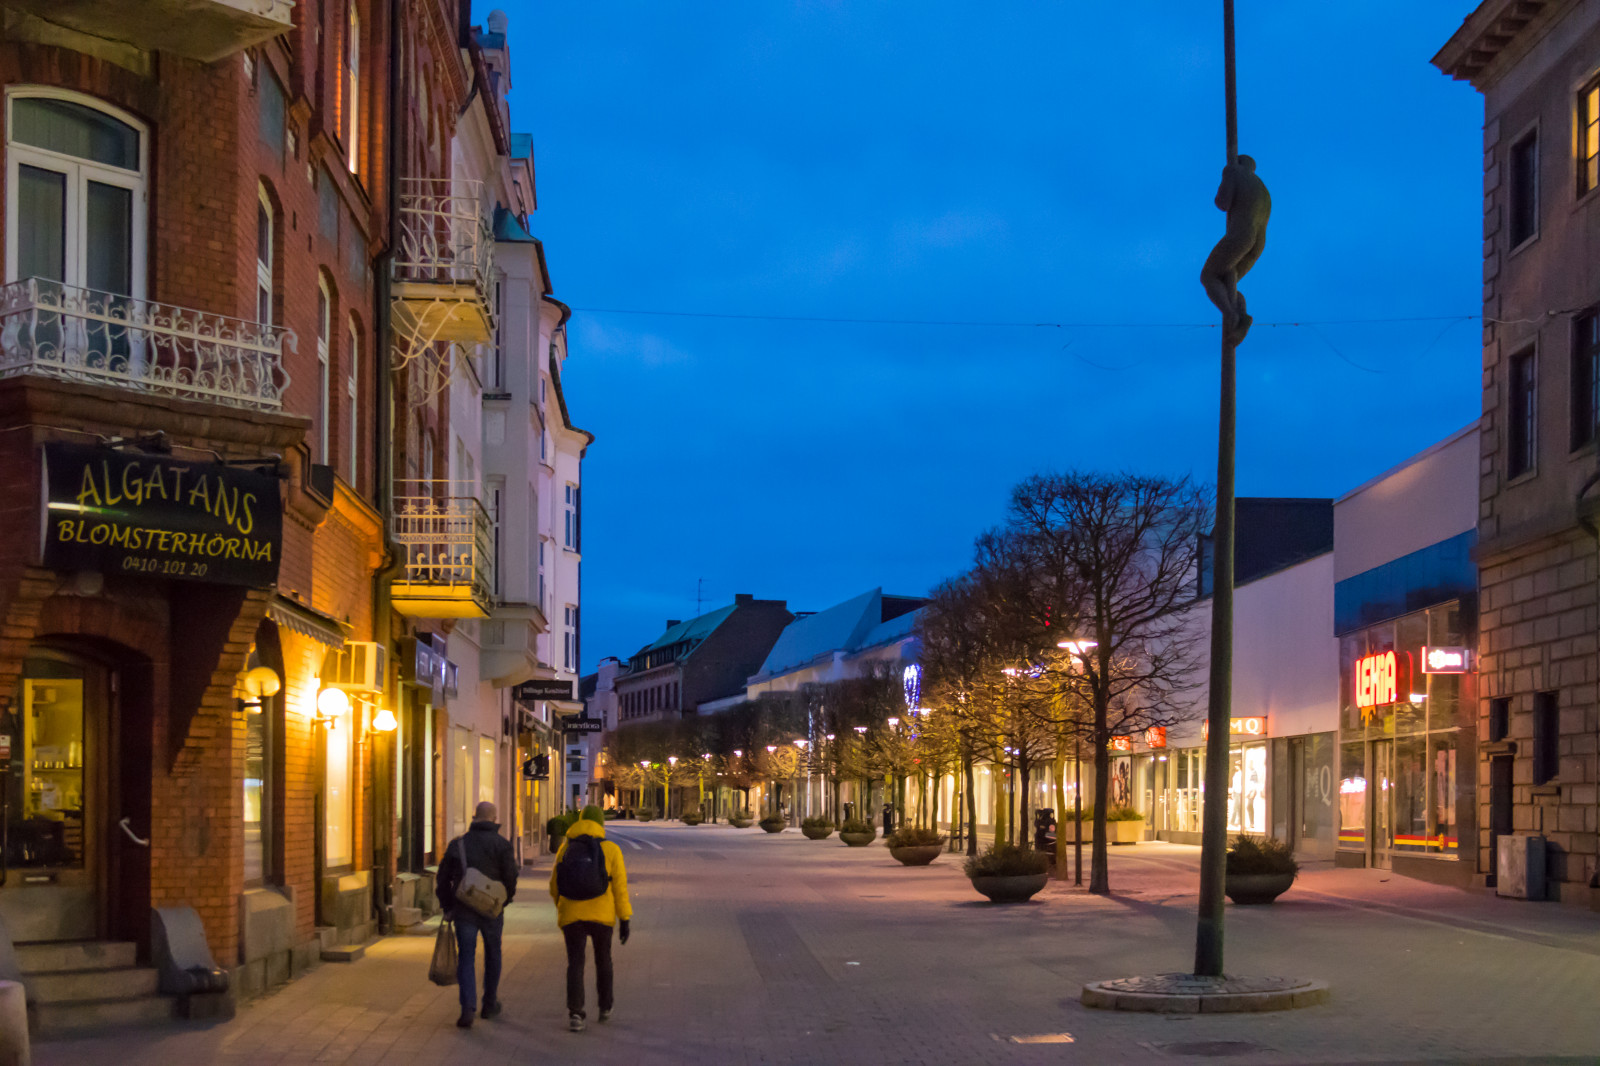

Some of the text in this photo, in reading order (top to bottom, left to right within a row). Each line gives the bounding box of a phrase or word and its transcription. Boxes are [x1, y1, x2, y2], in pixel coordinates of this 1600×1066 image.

[76, 460, 257, 535] ALGATANS
[57, 520, 272, 562] BLOMSTERHÖRNA
[190, 562, 208, 577] 20
[1306, 765, 1332, 806] MQ
